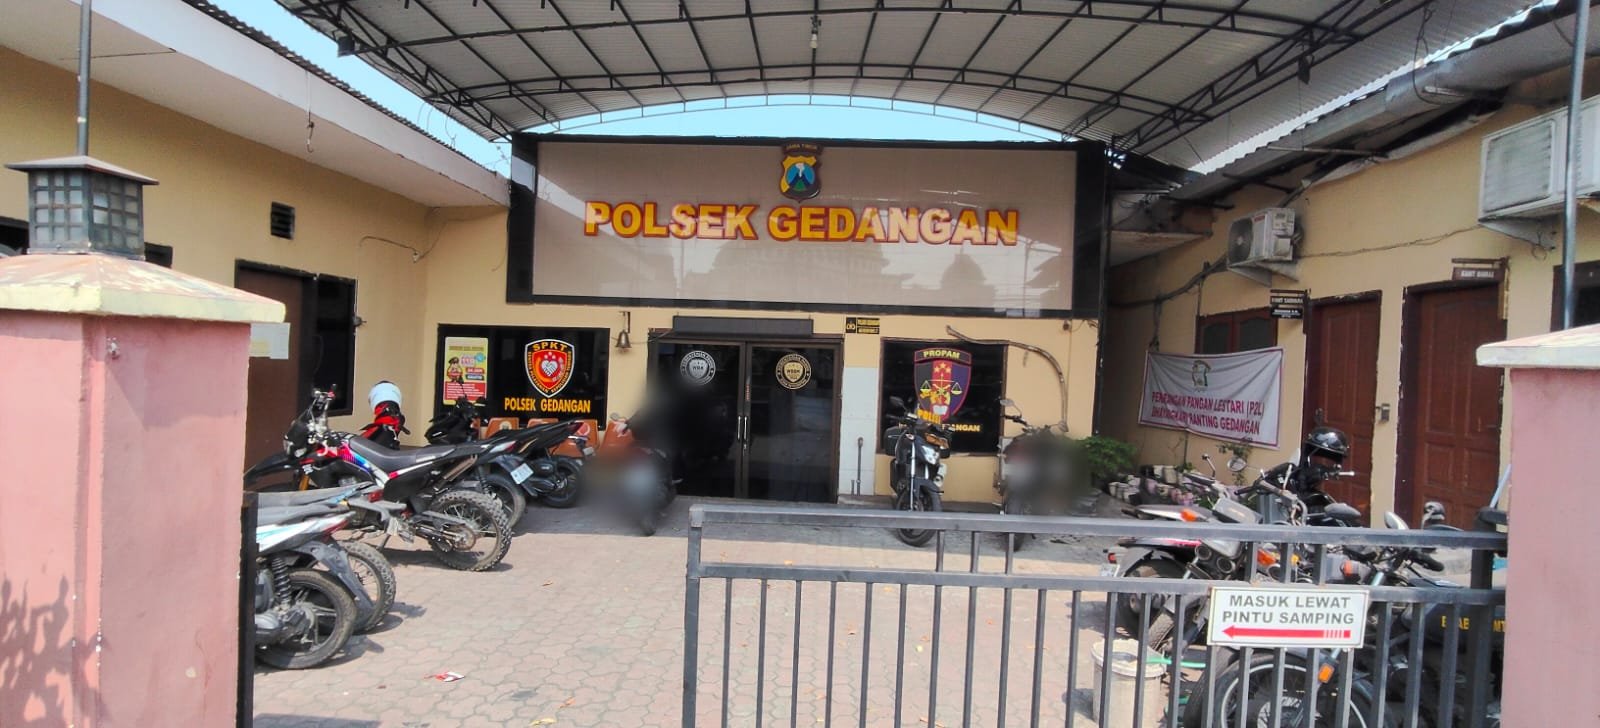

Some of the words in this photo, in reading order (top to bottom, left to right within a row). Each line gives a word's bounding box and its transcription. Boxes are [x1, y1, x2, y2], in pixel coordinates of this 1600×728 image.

[584, 202, 760, 240] POLSEK
[768, 206, 1019, 246] GEDANGAN
[532, 342, 567, 352] SPKT
[923, 349, 960, 359] PROPAM
[504, 398, 536, 412] POLSEK
[540, 399, 591, 413] GEDANGAN
[1186, 396, 1213, 412] PANGAN
[1213, 399, 1245, 415] LESTARI
[1246, 401, 1264, 418] (P2L)
[1188, 413, 1219, 430] RANTING
[1219, 417, 1260, 436] GEDANGAN
[1229, 594, 1290, 608] MASUK
[1295, 596, 1351, 609] LEWAT
[1222, 610, 1274, 624] PINTU
[1279, 611, 1355, 625] SAMPING
